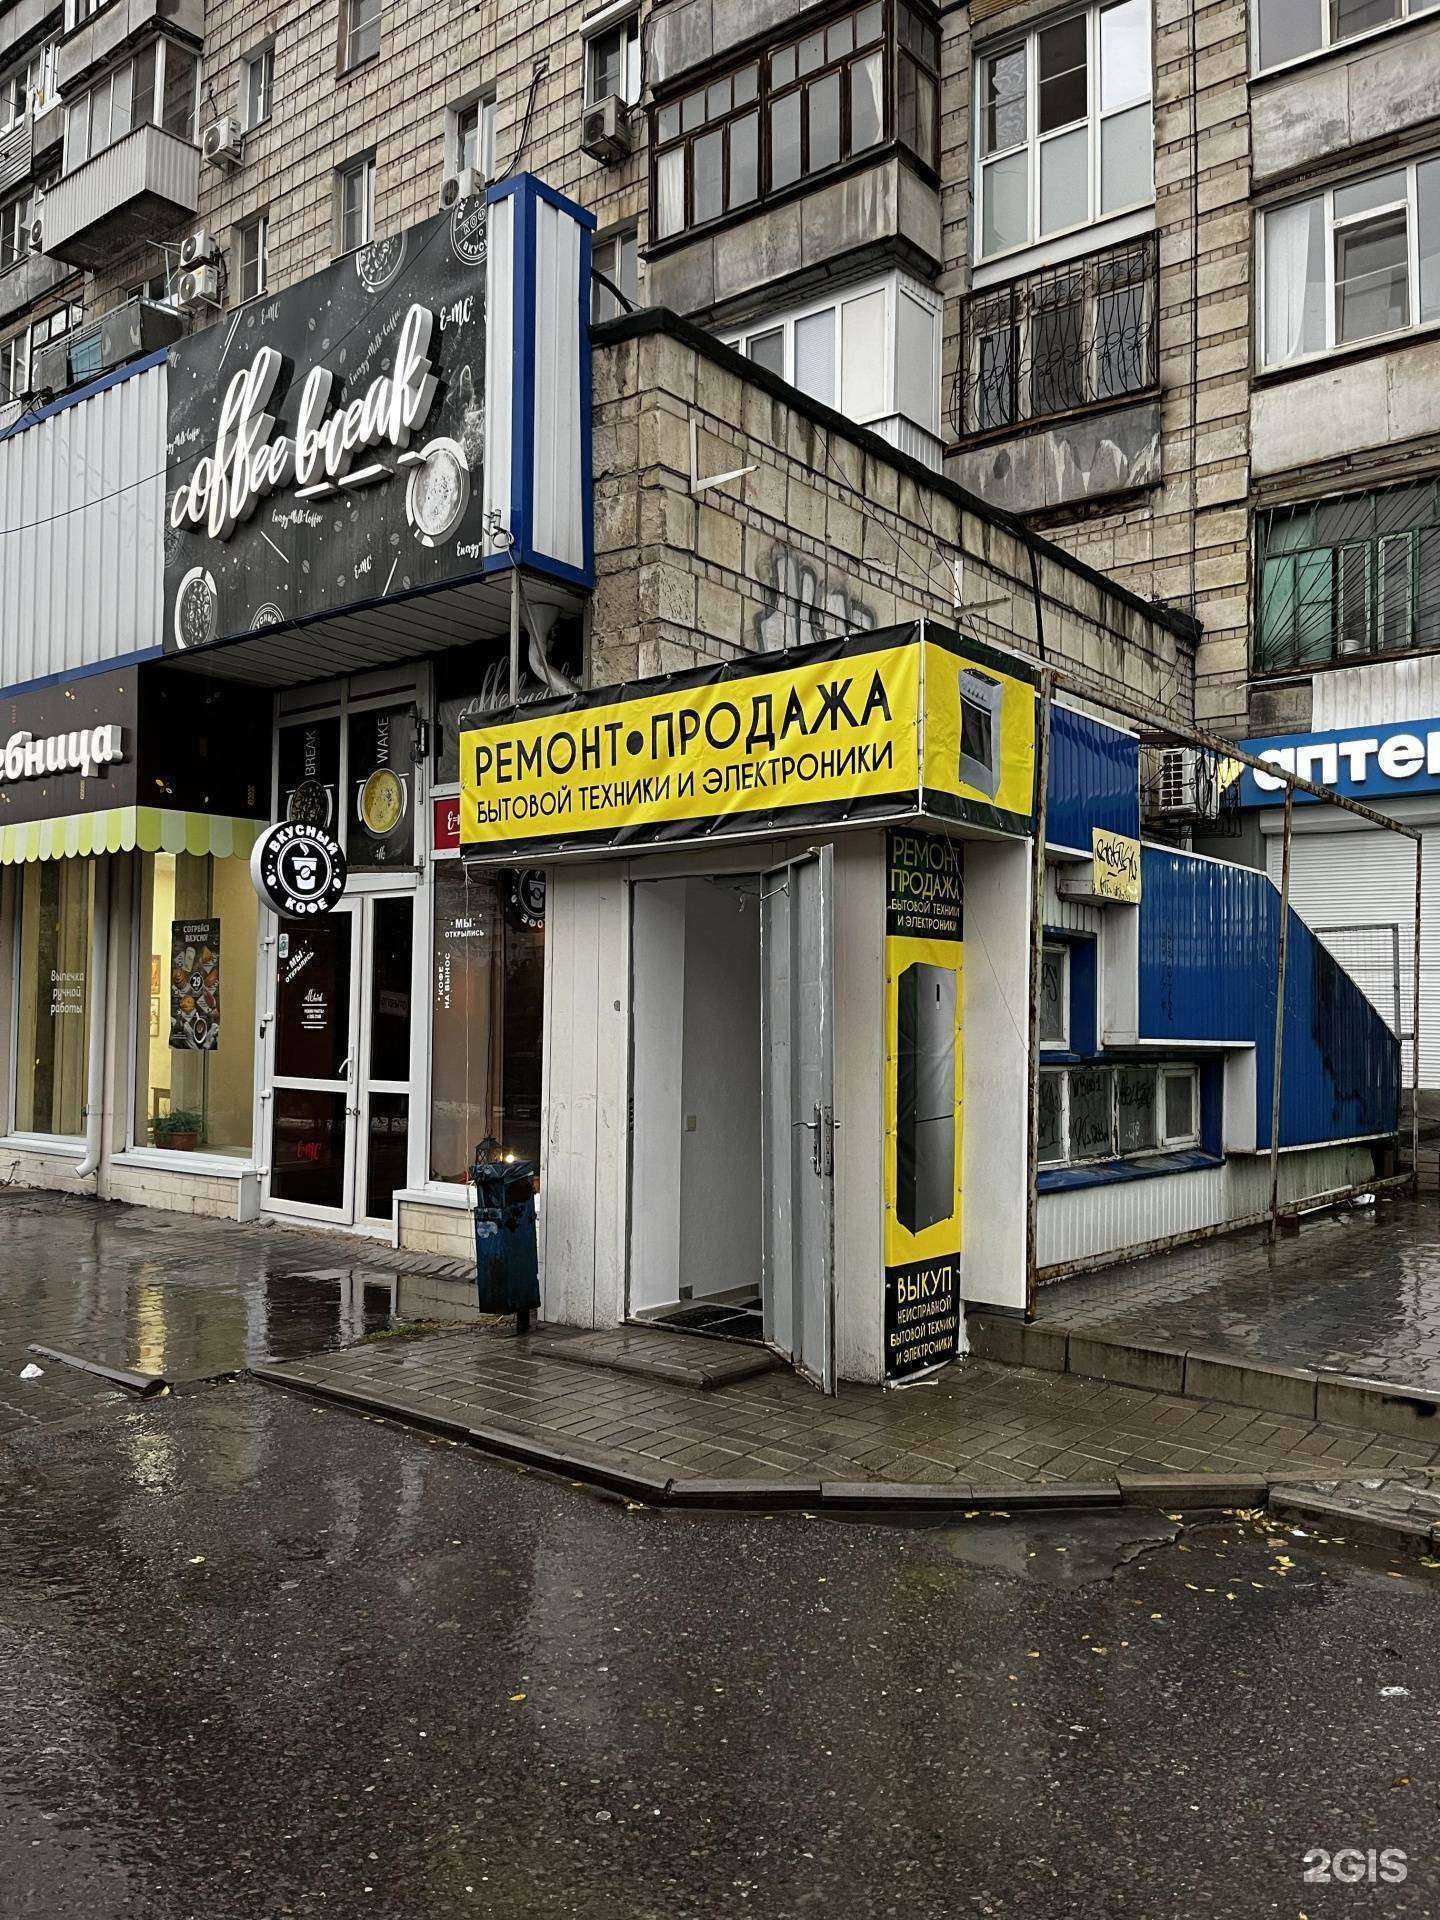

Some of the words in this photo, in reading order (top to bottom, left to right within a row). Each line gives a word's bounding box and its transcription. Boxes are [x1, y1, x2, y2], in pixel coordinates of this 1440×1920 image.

[171, 345, 294, 540] coffee
[294, 302, 437, 485] break
[377, 715, 390, 764] WAKE
[476, 721, 623, 787] РЕМОНТ
[651, 668, 893, 760] ПРОДАЖА
[304, 730, 316, 776] BREAK
[477, 784, 571, 824] БЫТОВОЙ
[578, 774, 670, 811] ТЕХНИКИ
[678, 770, 694, 798] И
[702, 740, 893, 795] ЭЛЕКТРОНИКИ
[268, 824, 339, 856] ВКУСНЫЙ
[893, 835, 960, 872] РЕМОНТ
[890, 868, 960, 901] ПРОДАЖА
[285, 897, 329, 914] КОФЕ
[891, 898, 931, 914] БЫТОВОЙ
[444, 929, 485, 939] ОТКРЫЛИСЬ
[455, 919, 472, 929] МЫ
[897, 915, 904, 926] И
[905, 915, 957, 932] ЭЛЕКТРОНИКИ
[51, 969, 84, 982] Выпечка
[53, 986, 81, 1001] ручной
[50, 1002, 83, 1016] работы
[897, 1265, 952, 1304] ВЫКУП
[897, 1295, 952, 1324] НЕИСПРАВНОЙ
[890, 1322, 926, 1347] БЫТОВОЙ
[896, 1352, 902, 1366] И
[903, 1335, 953, 1363] ЭЛЕКТРОНИКИ
